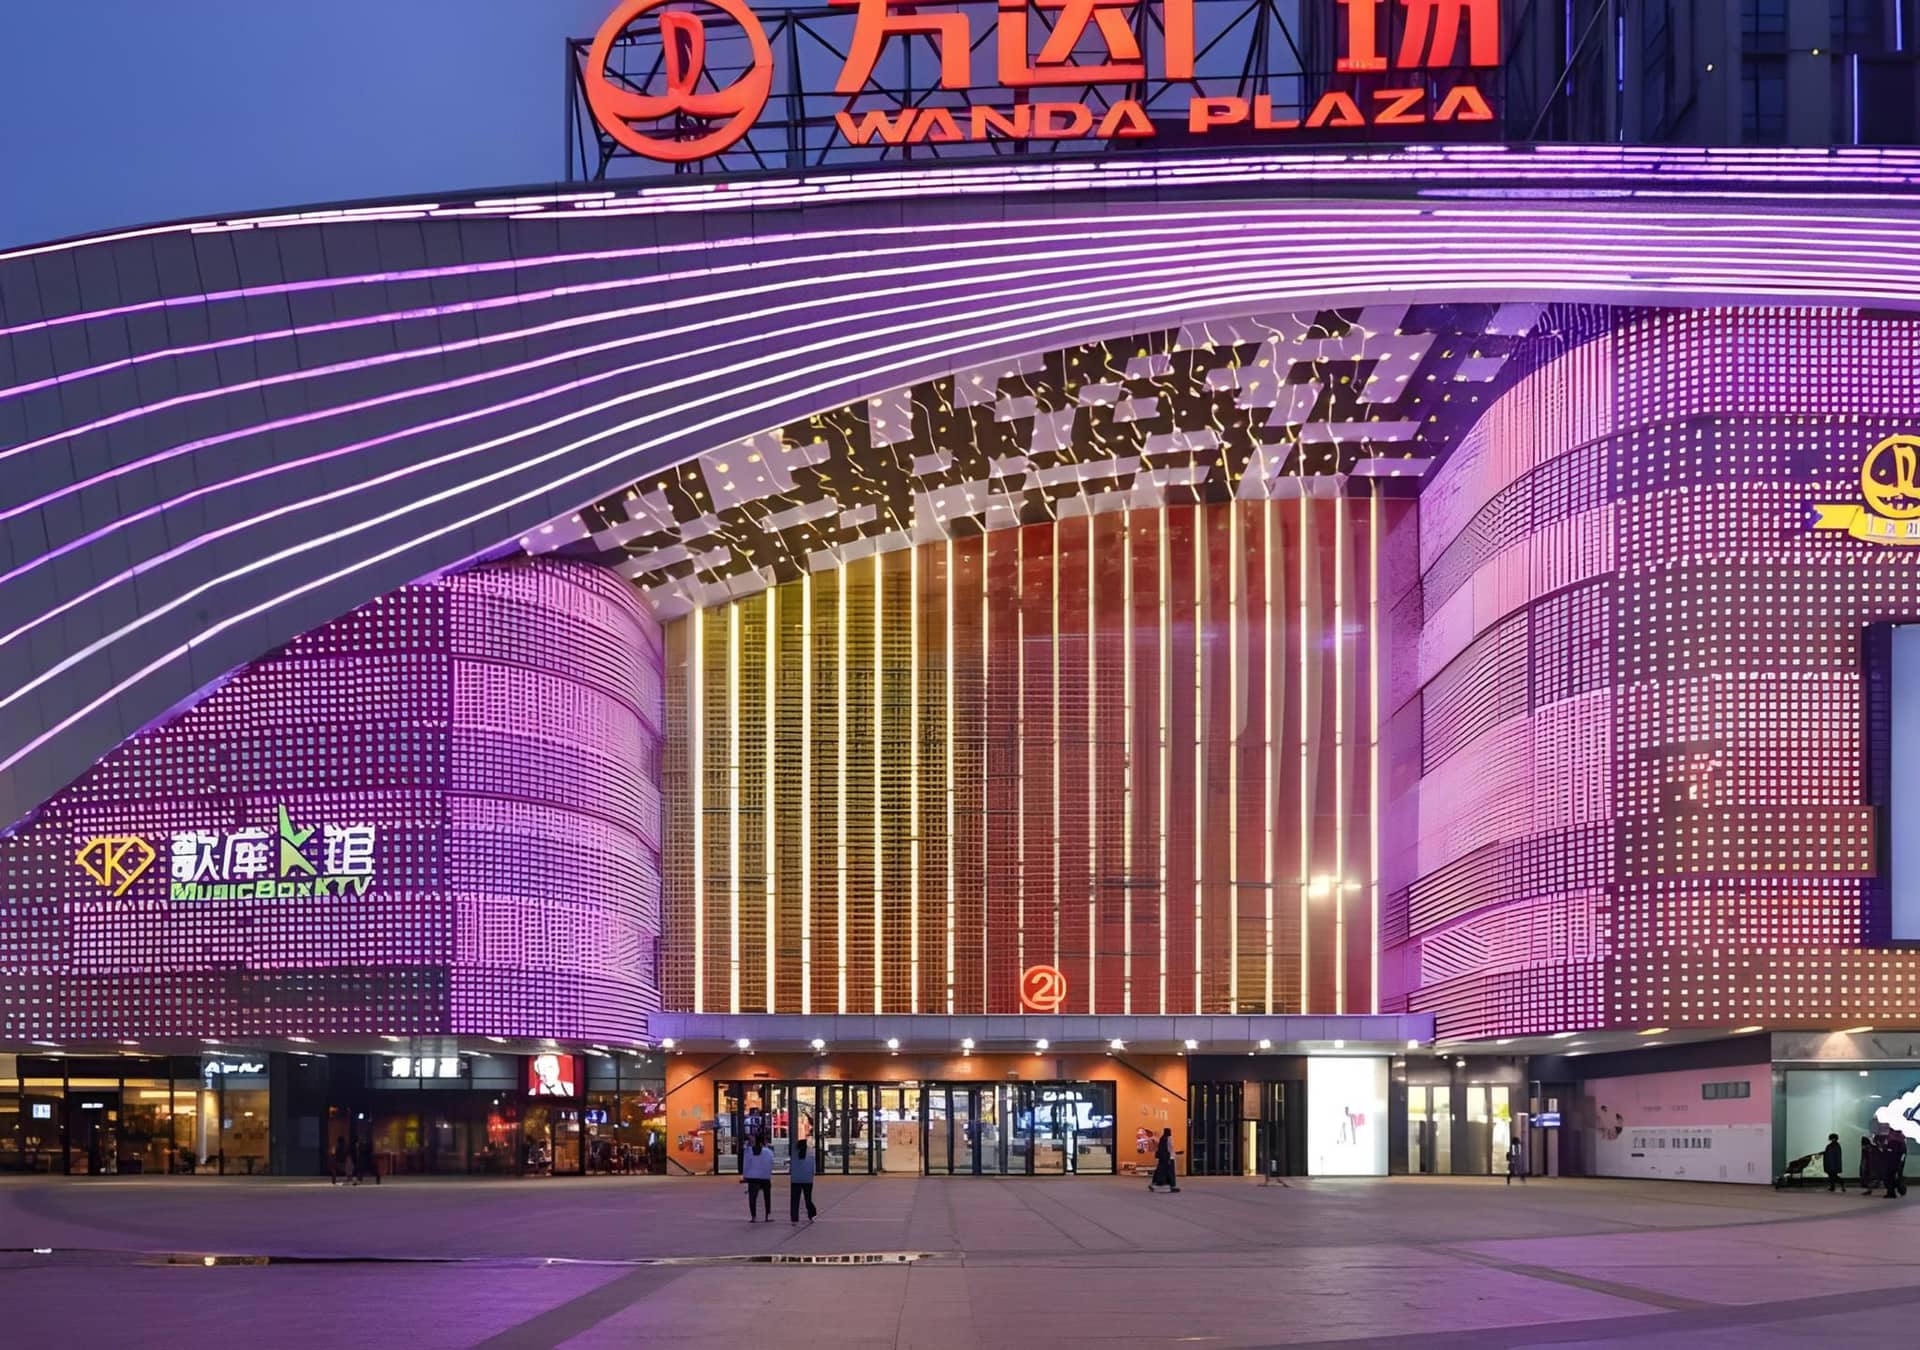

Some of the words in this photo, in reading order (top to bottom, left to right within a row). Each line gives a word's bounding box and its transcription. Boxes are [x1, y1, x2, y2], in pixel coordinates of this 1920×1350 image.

[834, 100, 1157, 146] WANDA
[1188, 85, 1494, 133] PLAZA
[1031, 972, 1060, 1001] 2
